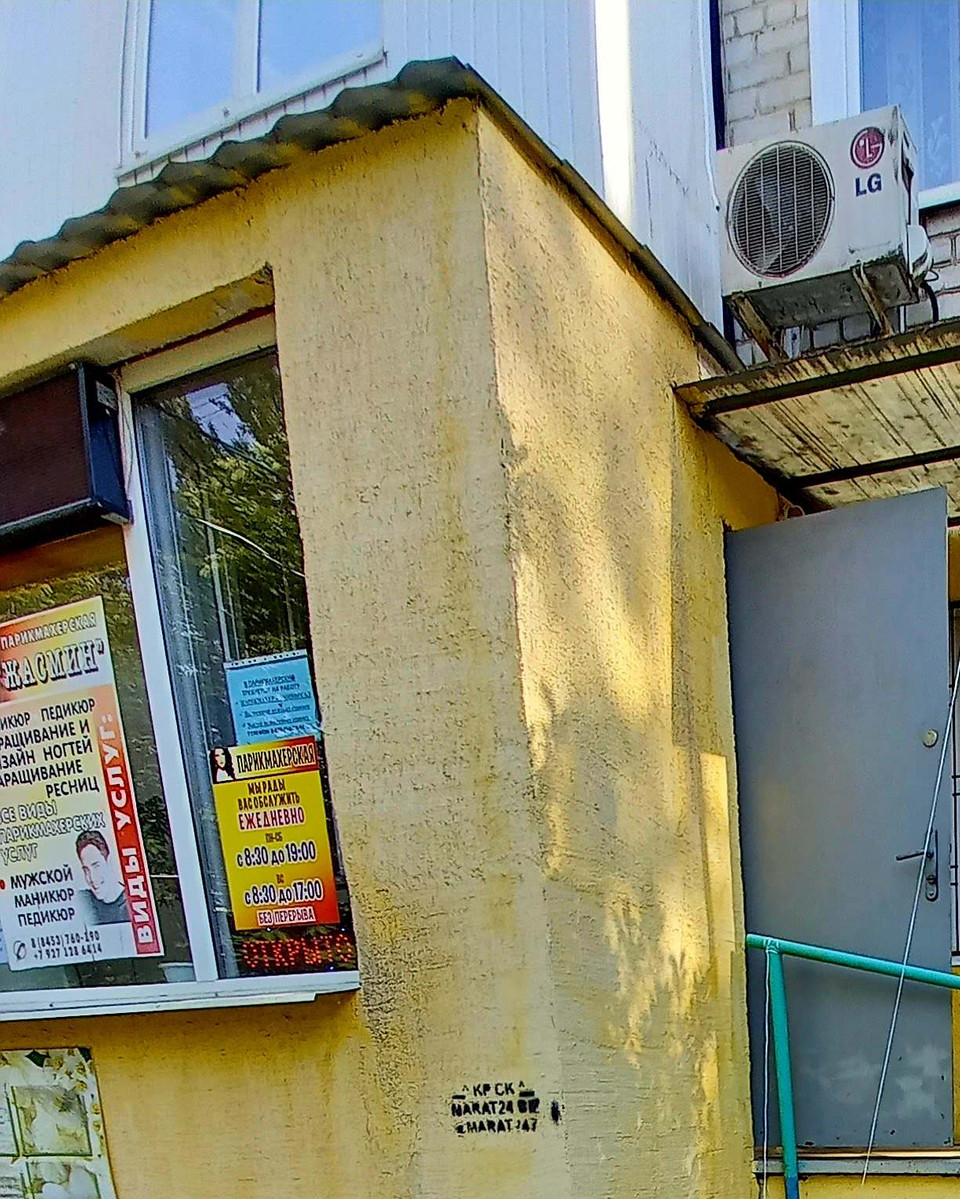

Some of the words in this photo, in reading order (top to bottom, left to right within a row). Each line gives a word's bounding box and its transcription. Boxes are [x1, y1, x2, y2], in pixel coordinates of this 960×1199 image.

[855, 173, 882, 197] LG
[0, 612, 97, 651] ПАРИКМАХЕРСКАЯ
[0, 712, 31, 731] ИКЮР
[41, 698, 96, 722] ПЕДИКЮР
[0, 721, 76, 750] РАЩИВАНИЕ
[79, 719, 90, 734] И
[0, 748, 36, 770] ЗАЙН
[43, 735, 93, 761] НОГТЕЙ
[236, 743, 315, 774] ПАРИКМАХЕРСКАЯ
[99, 714, 132, 832] УСЛУГ:
[46, 776, 100, 798] РЕСНИЦ
[248, 781, 262, 795] МЫ
[263, 778, 286, 793] РАДЫ
[0, 806, 16, 824] СЕ
[18, 799, 57, 821] ВИДЫ
[238, 796, 253, 811] ВАС
[253, 792, 300, 809] ОБСЛУЖИТЬ
[238, 806, 305, 831] ЕЖЕДНЕВНО
[1, 842, 38, 866] УСЛУГ
[244, 847, 268, 867] 8:30
[271, 850, 284, 866] до
[286, 841, 316, 862] 19:00
[10, 864, 73, 890] МУЖСКОЙ
[14, 888, 75, 909] МАНИКЮР
[122, 848, 154, 944] ВИДЫ
[252, 885, 276, 904] 8:30
[279, 889, 293, 904] до
[293, 880, 321, 900] 17:00
[17, 907, 75, 928] ПЕДИКЮР
[258, 912, 272, 924] БЕЗ
[275, 908, 314, 923] ПЕРЕРЫВА
[242, 933, 352, 968] ОТКРЫТО
